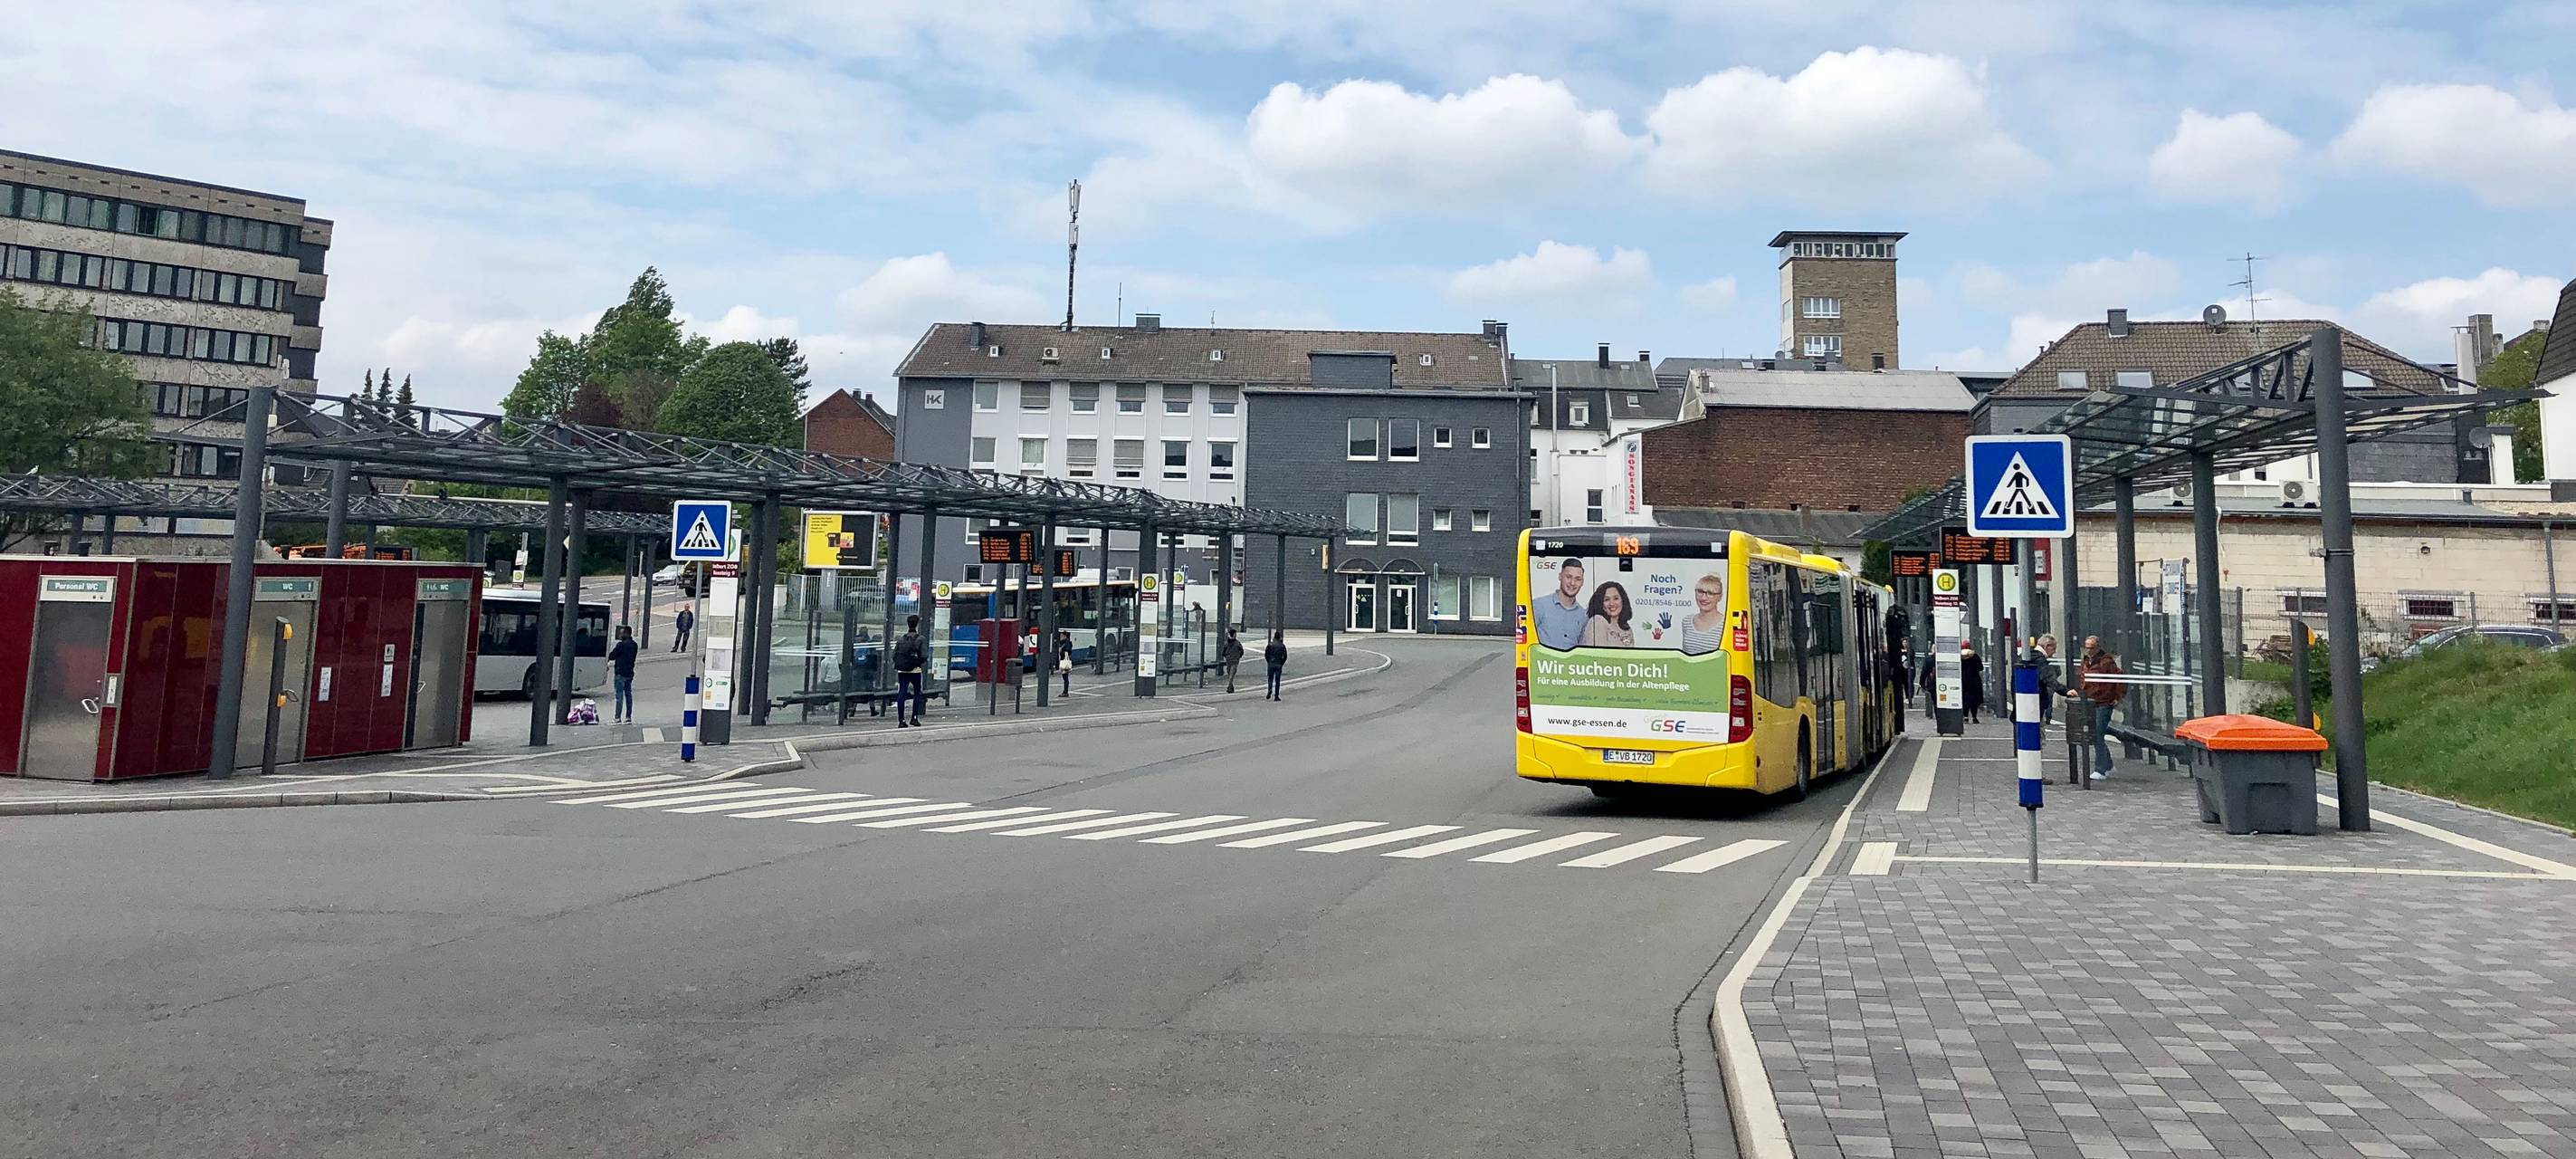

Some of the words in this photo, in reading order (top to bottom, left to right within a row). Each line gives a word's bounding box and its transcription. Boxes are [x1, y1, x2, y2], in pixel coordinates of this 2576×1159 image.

[1616, 536, 1639, 555] 169
[1536, 560, 1557, 570] GSE
[1650, 574, 1676, 584] Noch
[55, 582, 85, 590] Personal
[1644, 585, 1684, 597] Fragen?
[1635, 598, 1692, 608] 0201/8546-1000
[1537, 660, 1564, 675] Wir
[1567, 662, 1623, 676] suchen
[1628, 665, 1668, 678] Dich!
[1537, 676, 1550, 685] Für
[1551, 678, 1569, 686] eine
[1569, 678, 1615, 689] Ausbildung
[1617, 680, 1625, 688] in
[1627, 680, 1640, 689] der
[1642, 681, 1690, 692] Altenpflege
[1548, 717, 1627, 728] www.gse-essen.de
[1651, 719, 1686, 733] GSE
[1632, 752, 1652, 761] 1720
